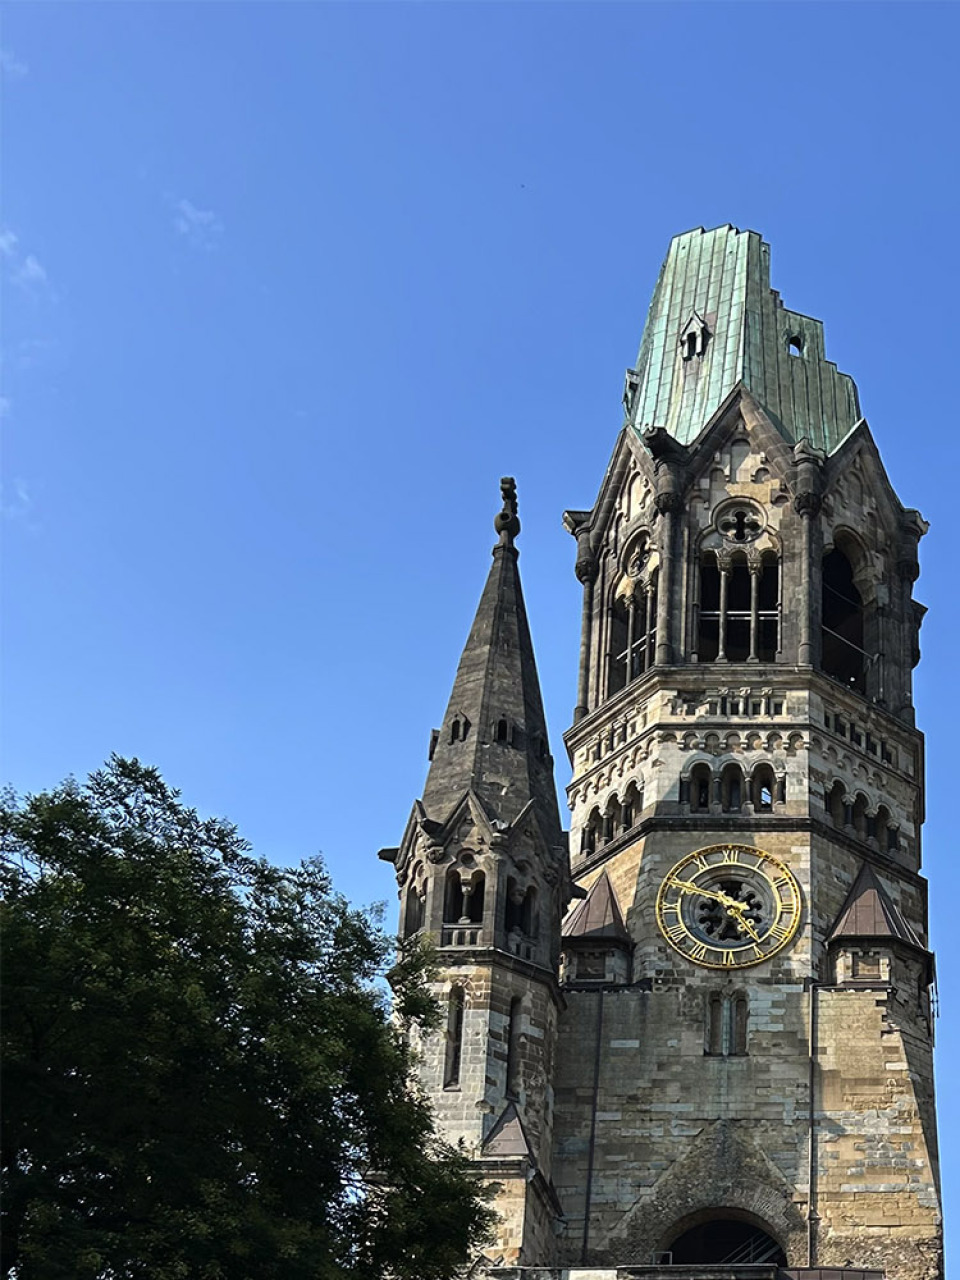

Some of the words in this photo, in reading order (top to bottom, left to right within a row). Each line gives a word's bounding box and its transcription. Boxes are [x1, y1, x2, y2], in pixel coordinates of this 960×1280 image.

[692, 854, 709, 871] XI
[722, 849, 739, 864] XII
[772, 875, 789, 888] II
[780, 902, 794, 913] III
